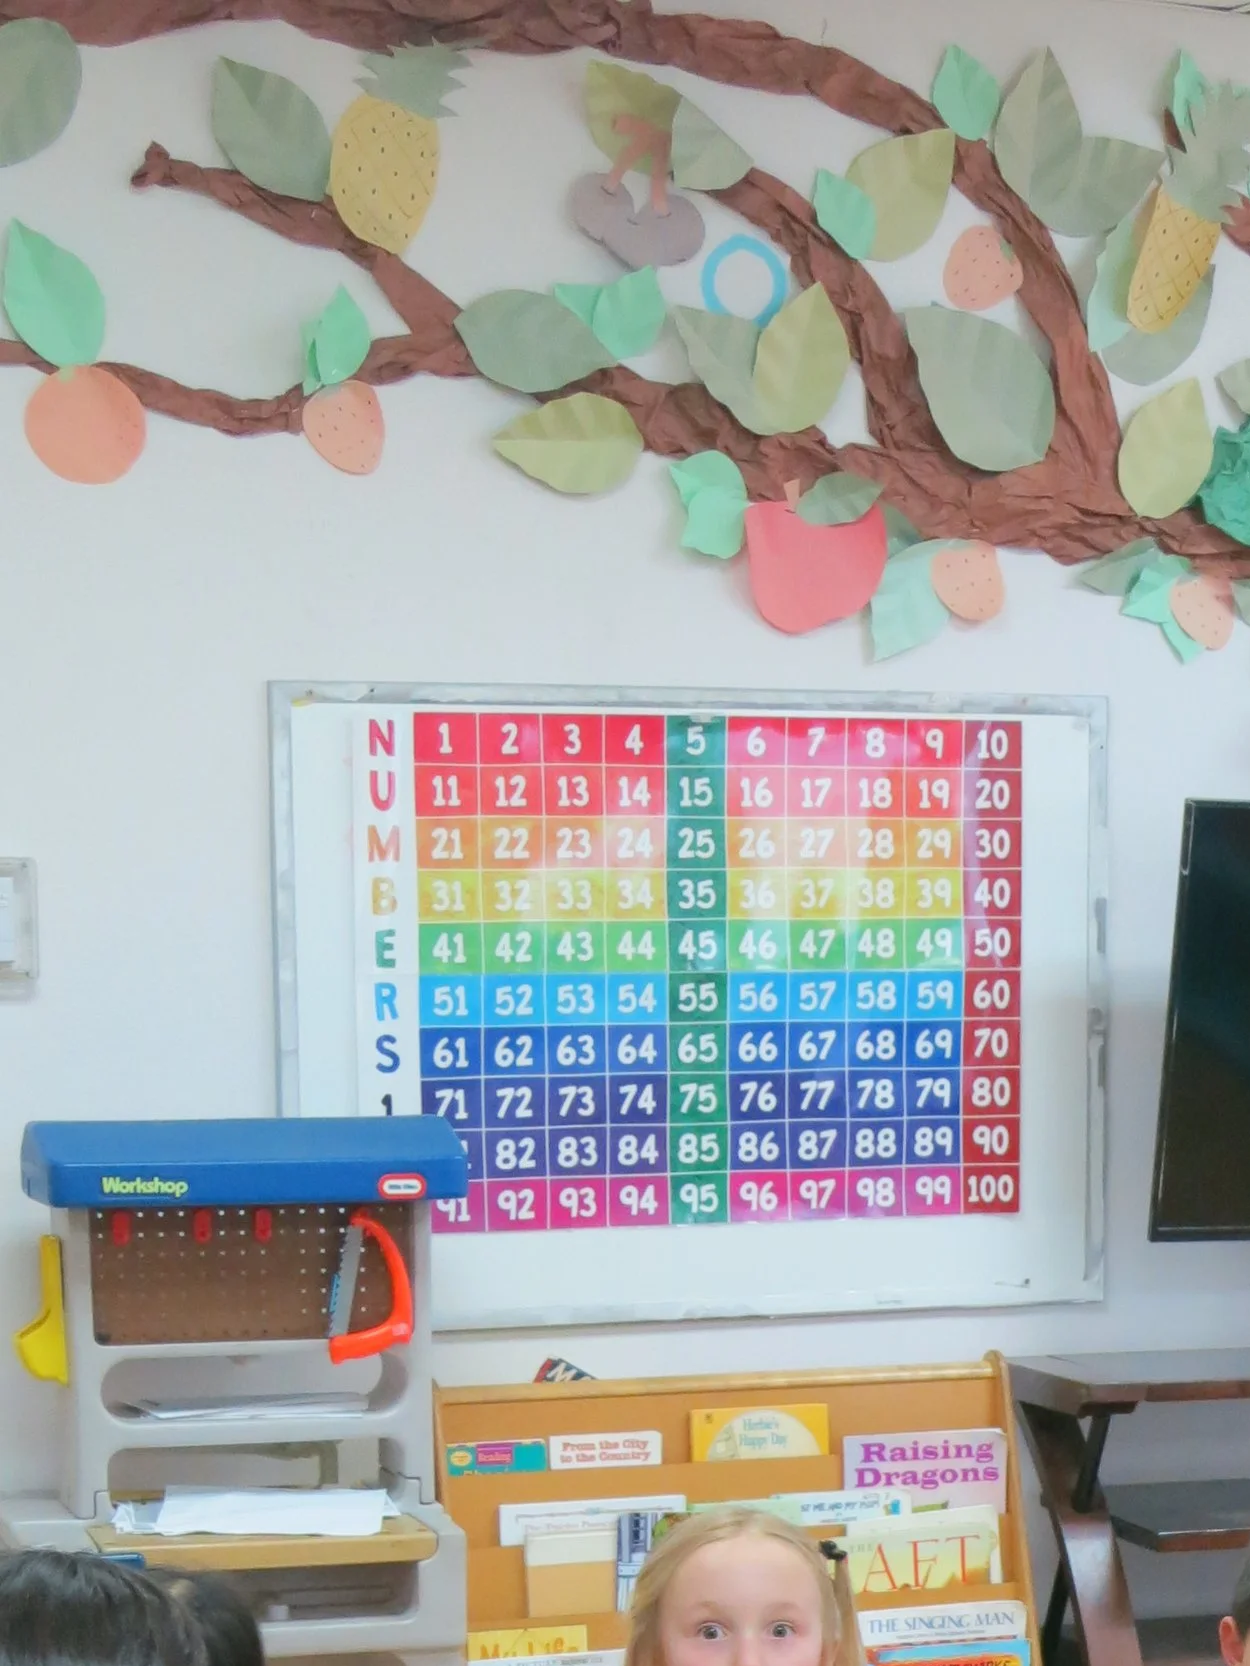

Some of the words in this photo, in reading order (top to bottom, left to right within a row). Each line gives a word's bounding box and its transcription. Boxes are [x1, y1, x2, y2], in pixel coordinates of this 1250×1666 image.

[438, 722, 453, 754] 1
[501, 722, 519, 755] 2
[564, 723, 582, 755] 3
[624, 724, 644, 756] 4
[686, 725, 706, 756] 5
[745, 726, 767, 758] 6
[807, 726, 827, 758] 7
[864, 727, 887, 760] 8
[925, 728, 944, 759] 9
[976, 728, 1009, 760] 10
[432, 775, 461, 807] 11
[495, 774, 527, 807] 12
[557, 775, 589, 807] 13
[618, 776, 651, 808] 14
[679, 776, 713, 807] 15
[740, 776, 774, 808] 16
[801, 777, 832, 808] 17
[858, 777, 892, 809] 18
[919, 778, 950, 809] 19
[974, 778, 1010, 810] 20
[431, 827, 464, 860] 21
[494, 827, 530, 859] 22
[555, 827, 593, 860] 23
[617, 826, 654, 859] 24
[678, 827, 715, 859] 25
[739, 827, 777, 860] 26
[799, 827, 835, 859] 27
[856, 827, 895, 860] 28
[917, 828, 952, 859] 29
[974, 828, 1011, 859] 30
[366, 718, 401, 1073] NUMBERS
[432, 879, 465, 912] 31
[495, 880, 532, 912] 32
[556, 879, 593, 911] 33
[617, 879, 654, 910] 34
[678, 879, 716, 909] 35
[740, 878, 777, 910] 36
[799, 878, 837, 910] 37
[856, 878, 896, 910] 38
[917, 877, 952, 909] 39
[973, 878, 1011, 908] 40
[432, 932, 466, 963] 41
[495, 930, 532, 963] 42
[556, 930, 594, 962] 43
[617, 930, 656, 961] 44
[678, 929, 718, 961] 45
[739, 929, 778, 961] 46
[799, 928, 837, 959] 47
[857, 927, 896, 959] 48
[916, 927, 953, 959] 49
[974, 925, 1011, 958] 50
[433, 985, 468, 1016] 51
[495, 984, 533, 1016] 52
[557, 983, 595, 1014] 53
[618, 983, 657, 1013] 54
[678, 982, 718, 1012] 55
[739, 982, 778, 1012] 56
[799, 980, 836, 1012] 57
[856, 980, 897, 1011] 58
[917, 980, 954, 1010] 59
[973, 979, 1010, 1009] 60
[433, 1037, 469, 1069] 61
[494, 1035, 533, 1068] 62
[556, 1034, 596, 1066] 63
[617, 1033, 657, 1065] 64
[678, 1032, 718, 1064] 65
[738, 1031, 778, 1062] 66
[798, 1030, 836, 1061] 67
[855, 1029, 897, 1060] 68
[915, 1028, 953, 1059] 69
[974, 1027, 1009, 1058] 70
[435, 1088, 468, 1120] 71
[496, 1086, 533, 1118] 72
[558, 1085, 595, 1117] 73
[619, 1084, 657, 1115] 74
[680, 1083, 717, 1113] 75
[740, 1081, 777, 1112] 76
[800, 1079, 835, 1110] 77
[857, 1078, 895, 1109] 78
[916, 1077, 951, 1108] 79
[971, 1076, 1011, 1107] 80
[495, 1137, 536, 1170] 82
[557, 1136, 598, 1168] 83
[617, 1134, 659, 1166] 84
[678, 1133, 720, 1164] 85
[738, 1131, 779, 1162] 86
[798, 1129, 837, 1161] 87
[855, 1127, 897, 1159] 88
[914, 1126, 953, 1157] 89
[972, 1125, 1009, 1155] 90
[102, 1176, 189, 1198] Workshop
[497, 1188, 535, 1220] 92
[559, 1187, 597, 1218] 93
[619, 1185, 658, 1216] 94
[680, 1183, 719, 1214] 95
[739, 1181, 778, 1215] 96
[799, 1178, 836, 1210] 97
[856, 1177, 896, 1208] 98
[915, 1175, 951, 1205] 99
[968, 1174, 1014, 1203] 100
[559, 1454, 573, 1464] to
[576, 1452, 596, 1463] the
[599, 1450, 652, 1462] Country
[562, 1442, 596, 1452] From
[599, 1440, 619, 1450] the
[622, 1439, 650, 1450] City
[860, 1440, 994, 1464] Raising
[854, 1465, 1000, 1489] Dragons
[862, 1532, 981, 1592] AFT
[869, 1618, 899, 1634] THE
[903, 1613, 971, 1631] SINGING
[974, 1610, 1016, 1627] MAN
